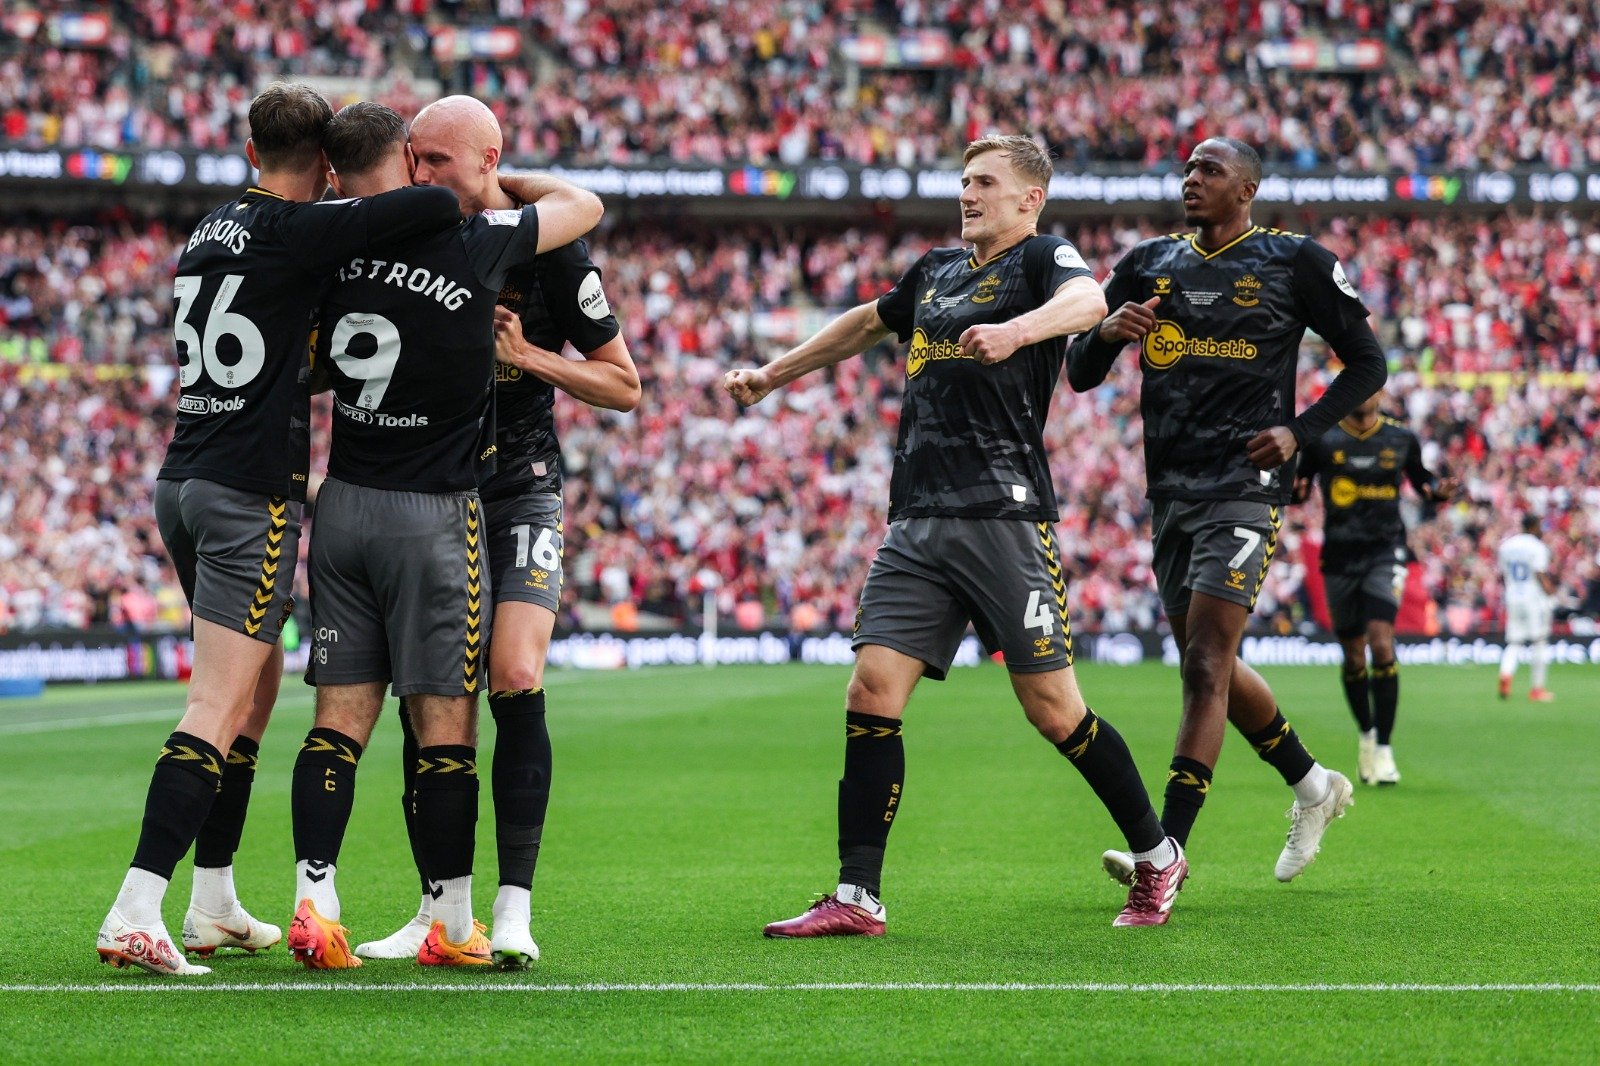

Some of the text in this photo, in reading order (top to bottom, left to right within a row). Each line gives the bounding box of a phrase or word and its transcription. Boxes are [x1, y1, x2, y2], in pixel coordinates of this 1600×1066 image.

[186, 218, 251, 255] BROOKS
[173, 274, 265, 389] 36
[1153, 335, 1257, 360] Sportsbet.io
[330, 312, 401, 410] 9
[909, 339, 974, 365] Sportsbe
[210, 396, 246, 413] Tools
[375, 414, 429, 427] Tools
[510, 524, 559, 571] 16
[1228, 526, 1261, 569] 7
[525, 580, 549, 591] hummel
[1023, 590, 1054, 636] 4
